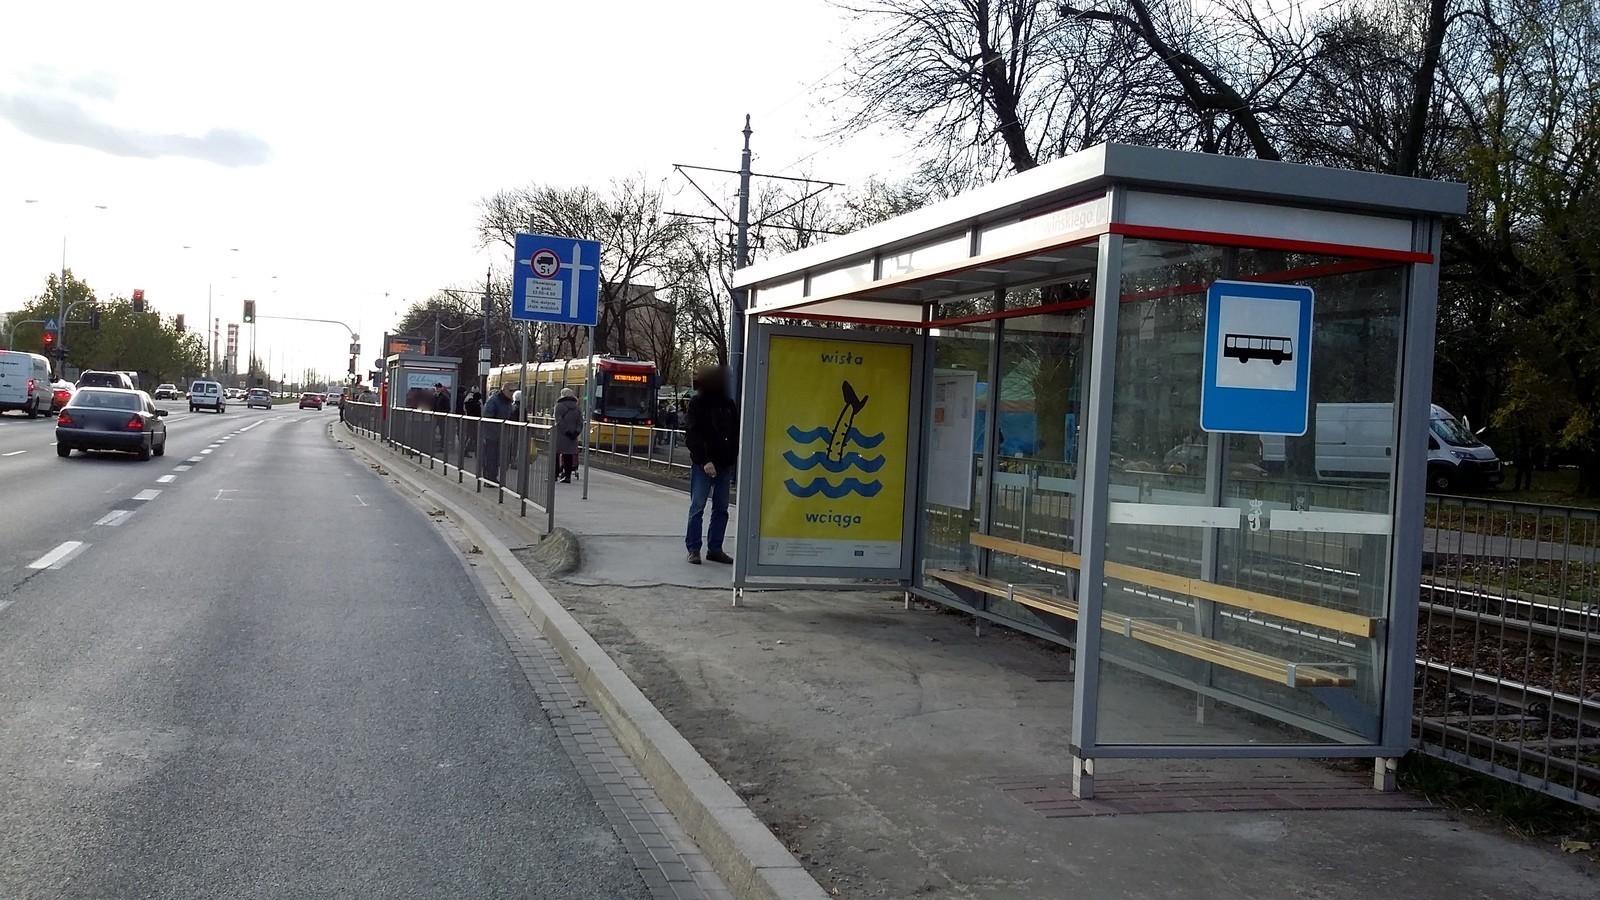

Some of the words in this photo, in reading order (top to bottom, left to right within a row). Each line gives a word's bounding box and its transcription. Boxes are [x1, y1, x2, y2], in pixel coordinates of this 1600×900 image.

[821, 351, 863, 365] wisła
[642, 375, 647, 383] 11
[805, 509, 862, 528] wciąga
